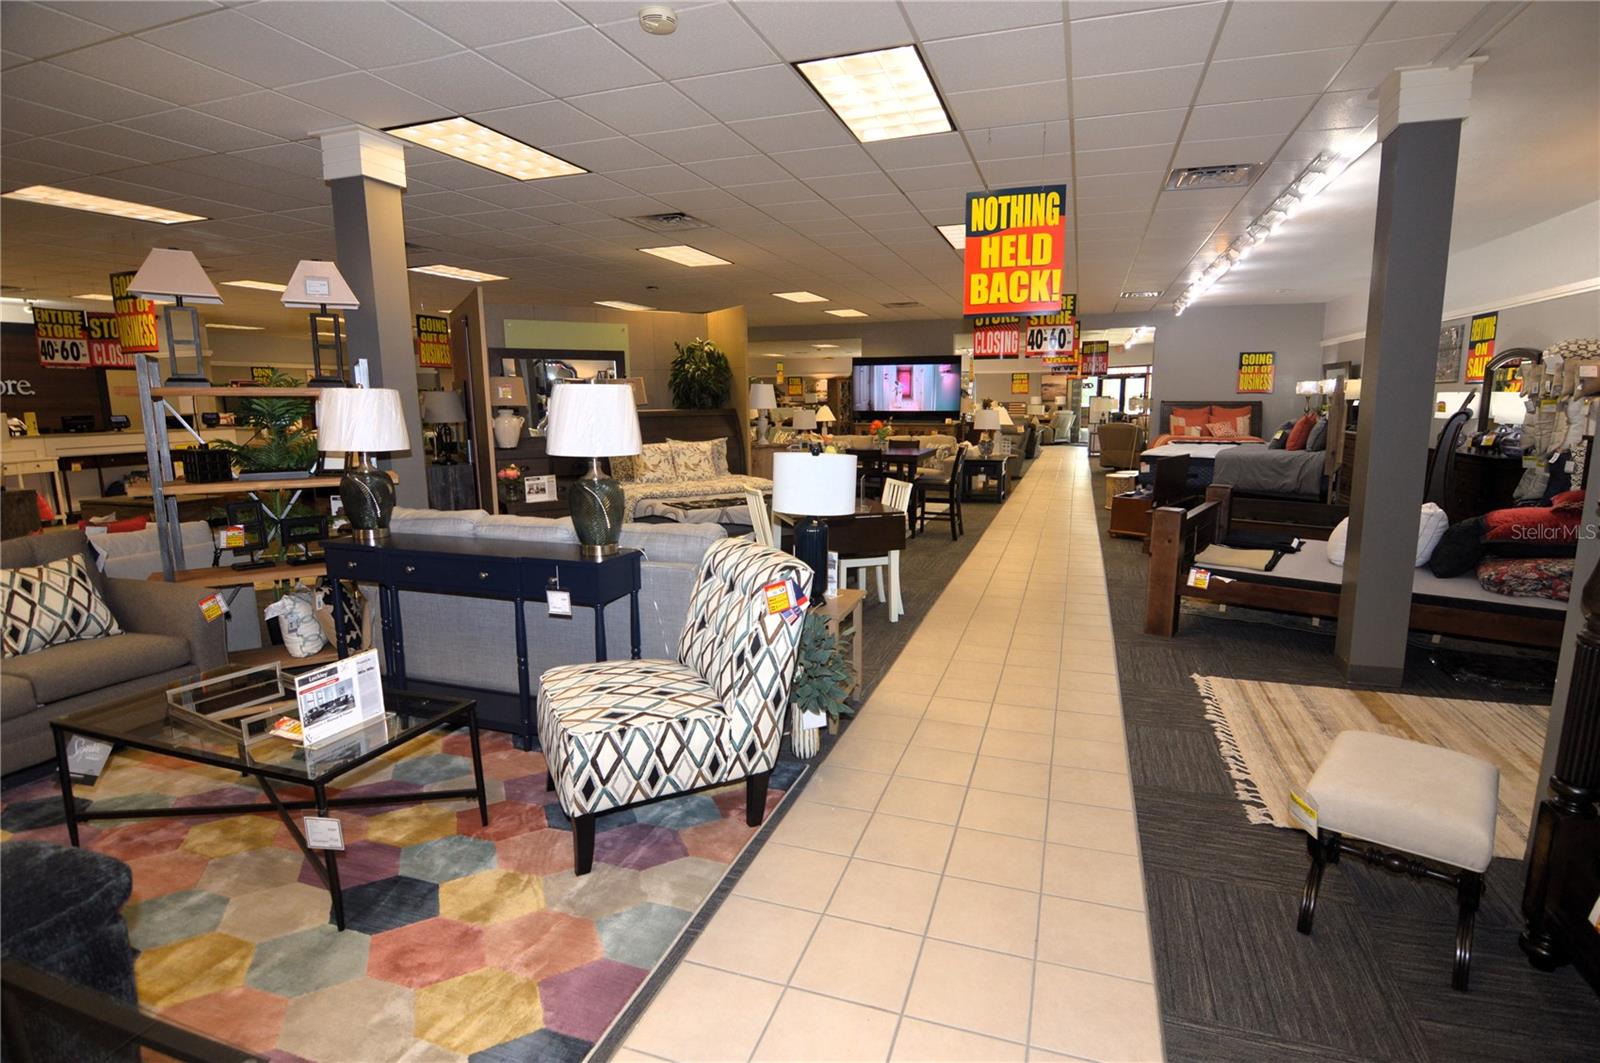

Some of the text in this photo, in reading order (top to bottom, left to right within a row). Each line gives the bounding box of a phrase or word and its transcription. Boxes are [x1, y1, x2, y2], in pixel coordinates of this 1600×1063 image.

[971, 192, 1060, 232] NOTHING
[981, 233, 1052, 269] HELD
[113, 275, 137, 297] GOI
[970, 269, 1061, 305] BACK!
[116, 299, 152, 313] OUT OF
[35, 308, 82, 325] ENTIRE
[419, 317, 447, 333] GOING
[38, 323, 83, 338] STORE
[90, 318, 119, 338] STO
[119, 314, 156, 348] BUSINESS
[421, 332, 437, 342] OUT
[975, 330, 1018, 353] CLOSING
[420, 343, 451, 364] BUSINESS
[1475, 342, 1488, 355] ON
[1242, 354, 1273, 365] GOING
[1241, 366, 1273, 374] OUT OF
[1239, 374, 1273, 391] BUSINESS
